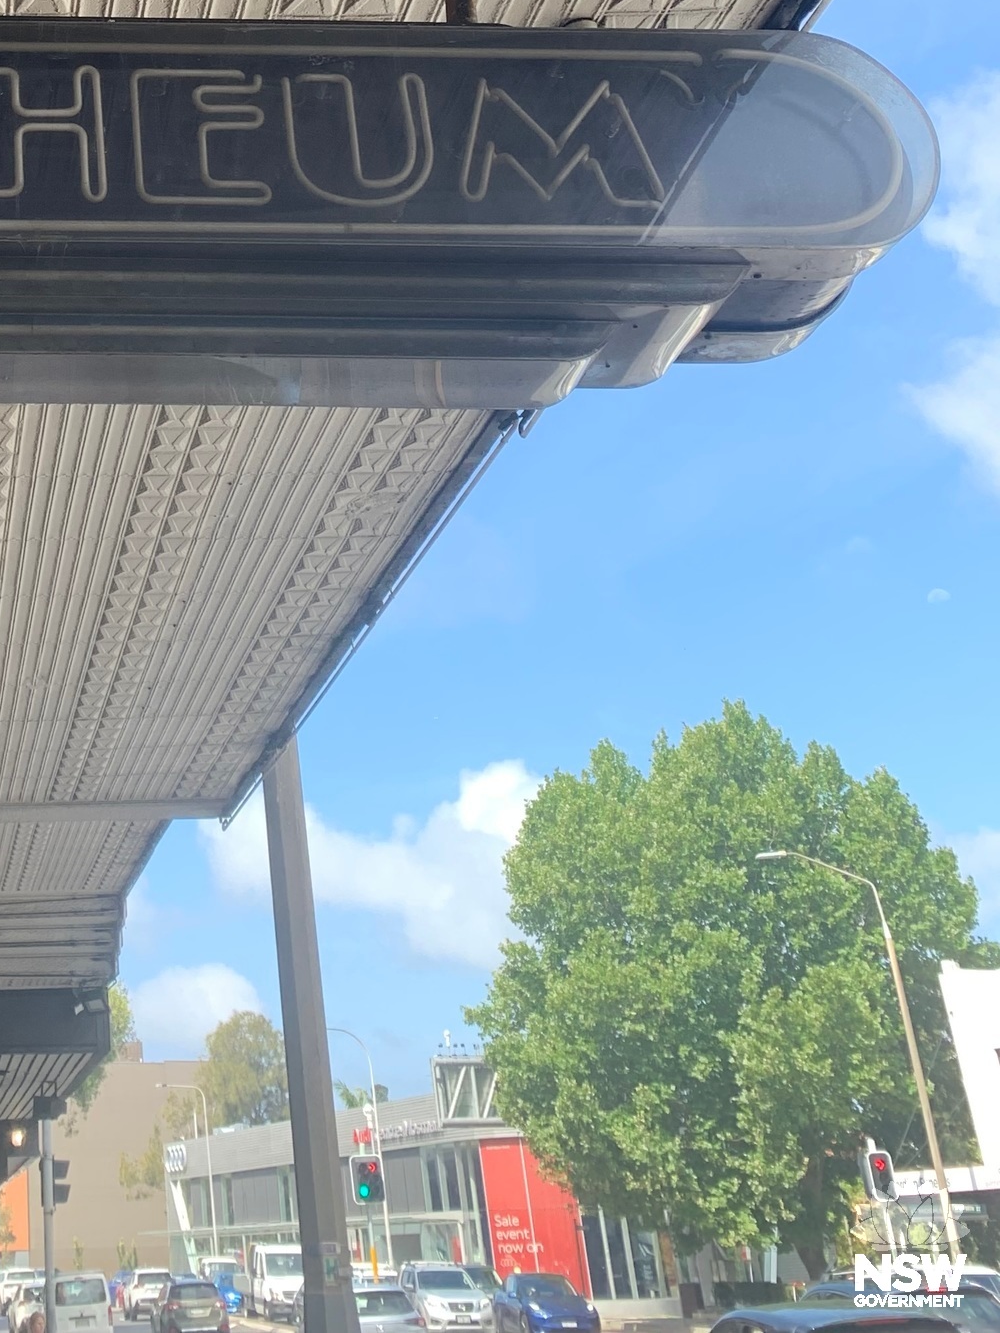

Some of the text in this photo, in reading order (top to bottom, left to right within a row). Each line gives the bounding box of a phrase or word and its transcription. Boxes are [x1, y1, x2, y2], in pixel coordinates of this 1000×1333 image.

[494, 1213, 520, 1228] Sale
[496, 1228, 531, 1241] event
[498, 1241, 545, 1254] now on
